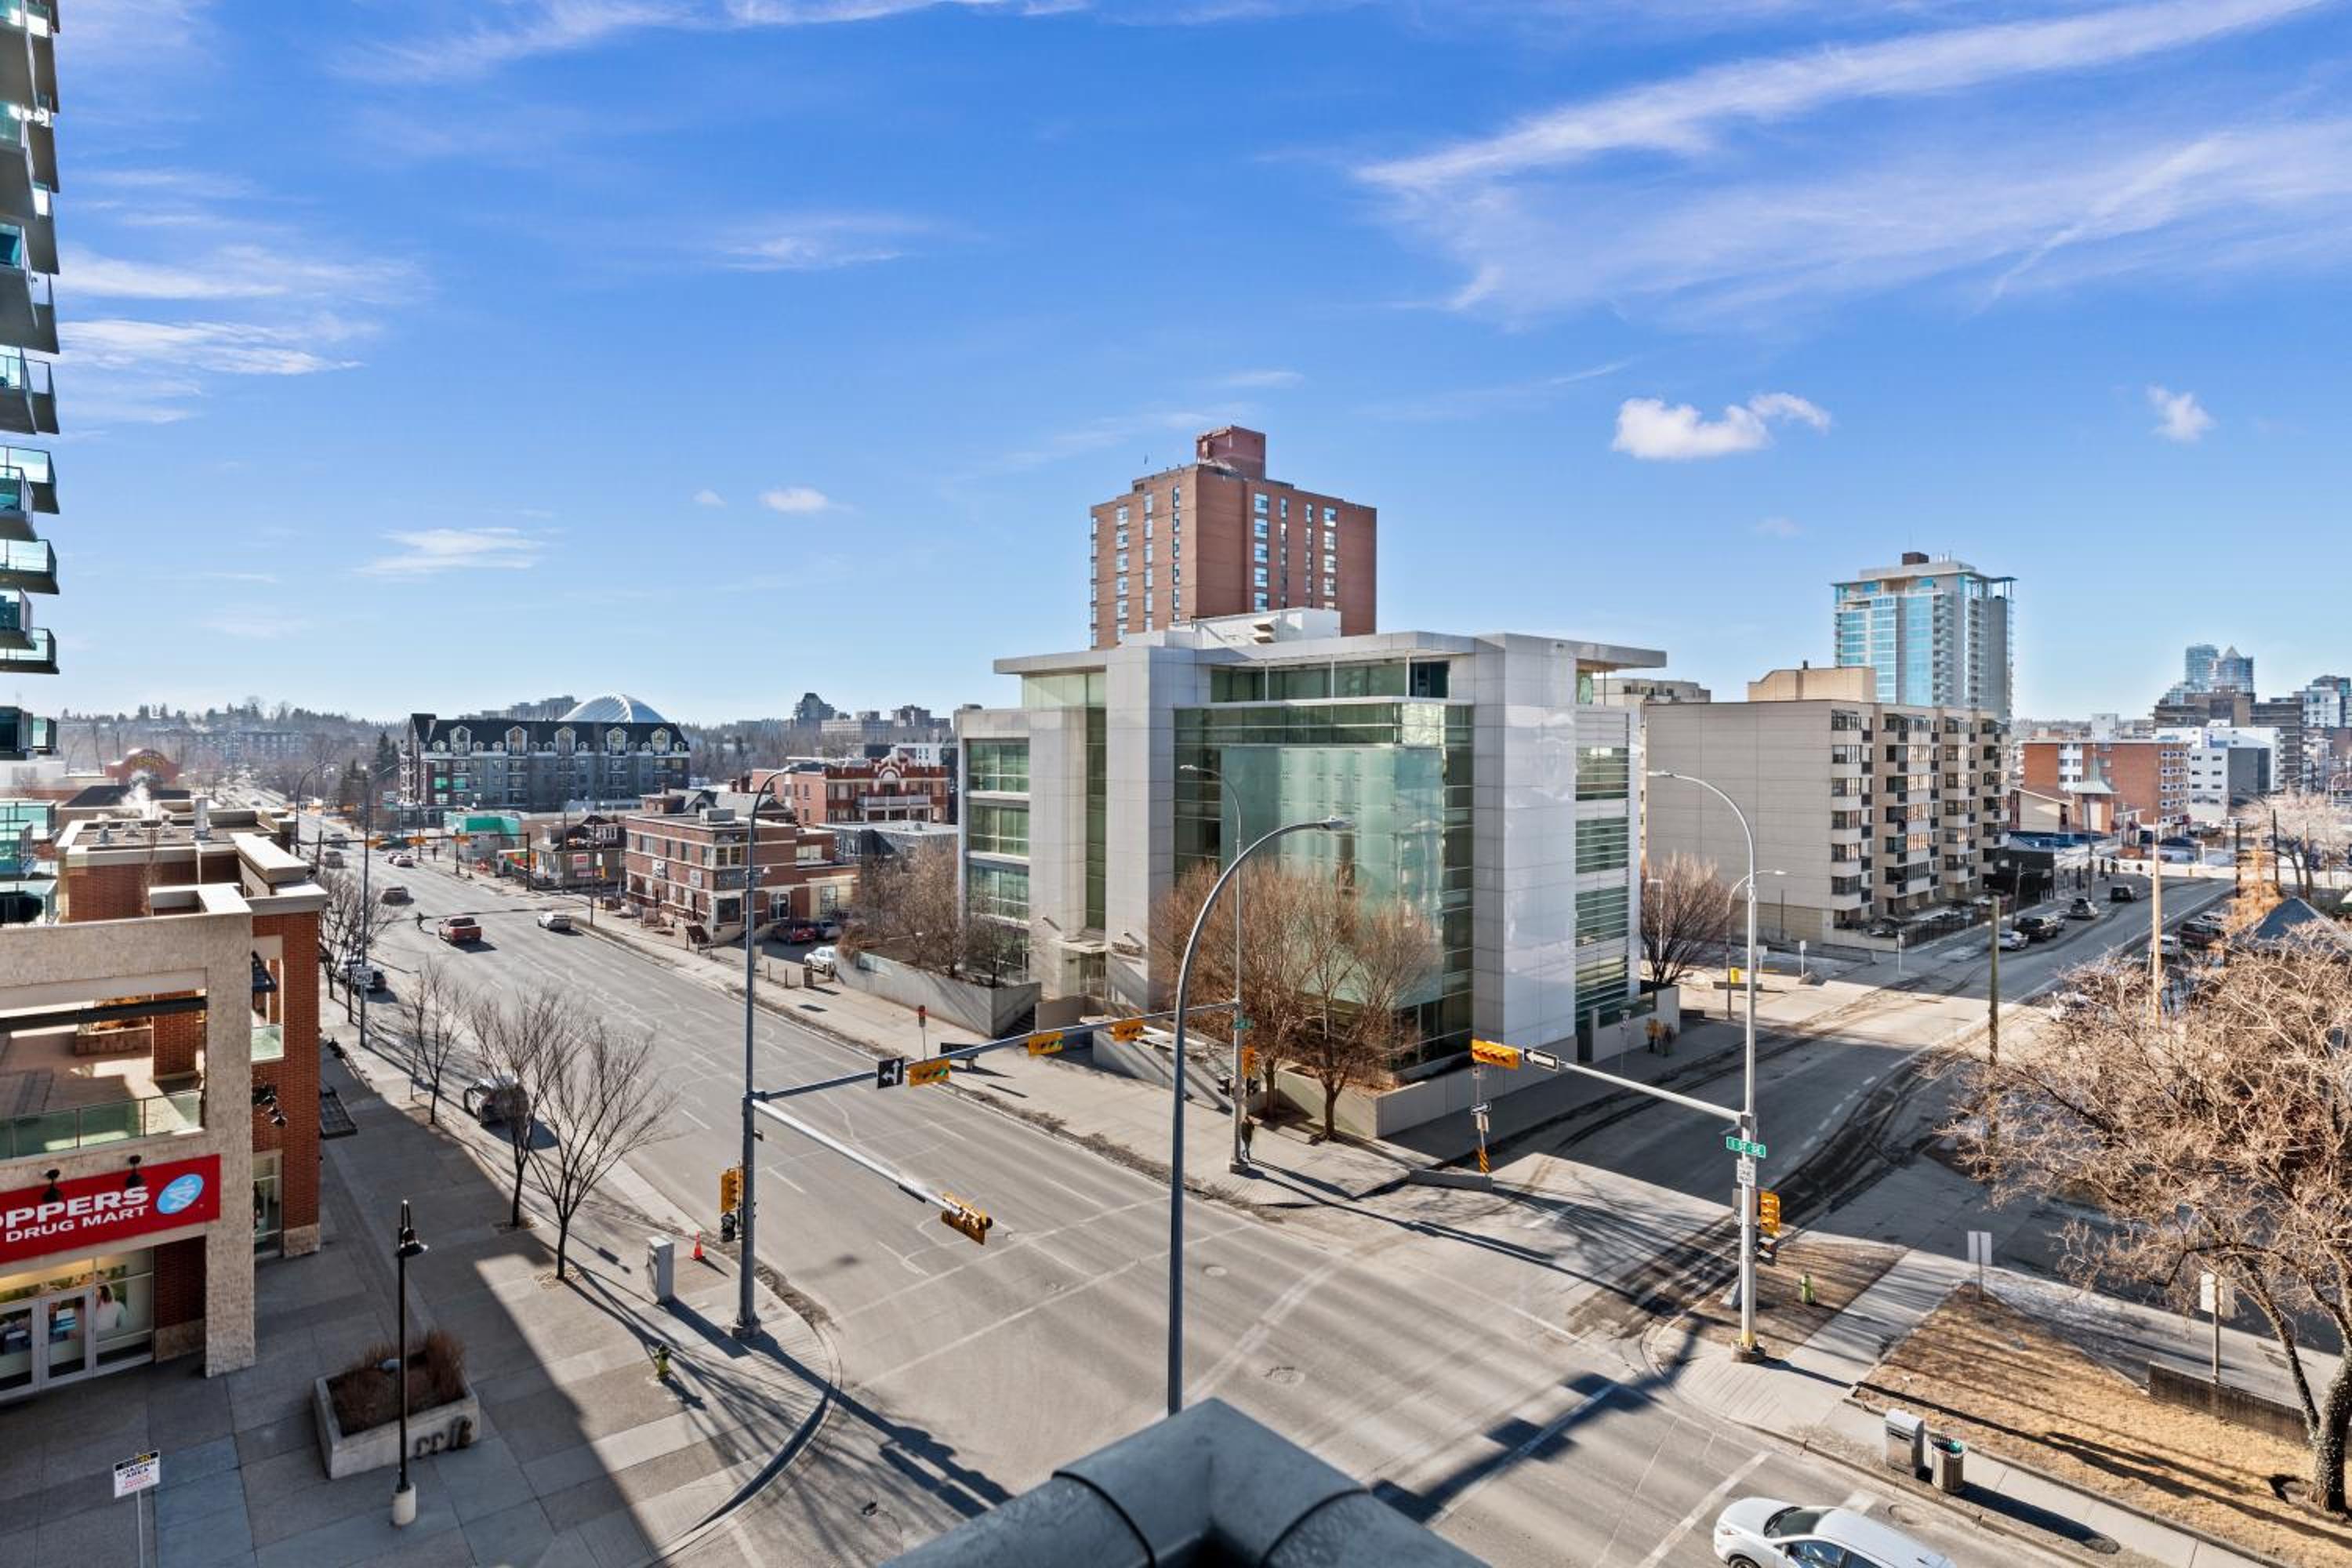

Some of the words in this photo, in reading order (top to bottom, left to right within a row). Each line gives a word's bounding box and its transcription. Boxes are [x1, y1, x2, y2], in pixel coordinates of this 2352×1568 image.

[357, 973, 371, 982] 50
[0, 1186, 149, 1229] PPERS
[5, 1219, 75, 1243] DRUG
[82, 1205, 148, 1227] MART
